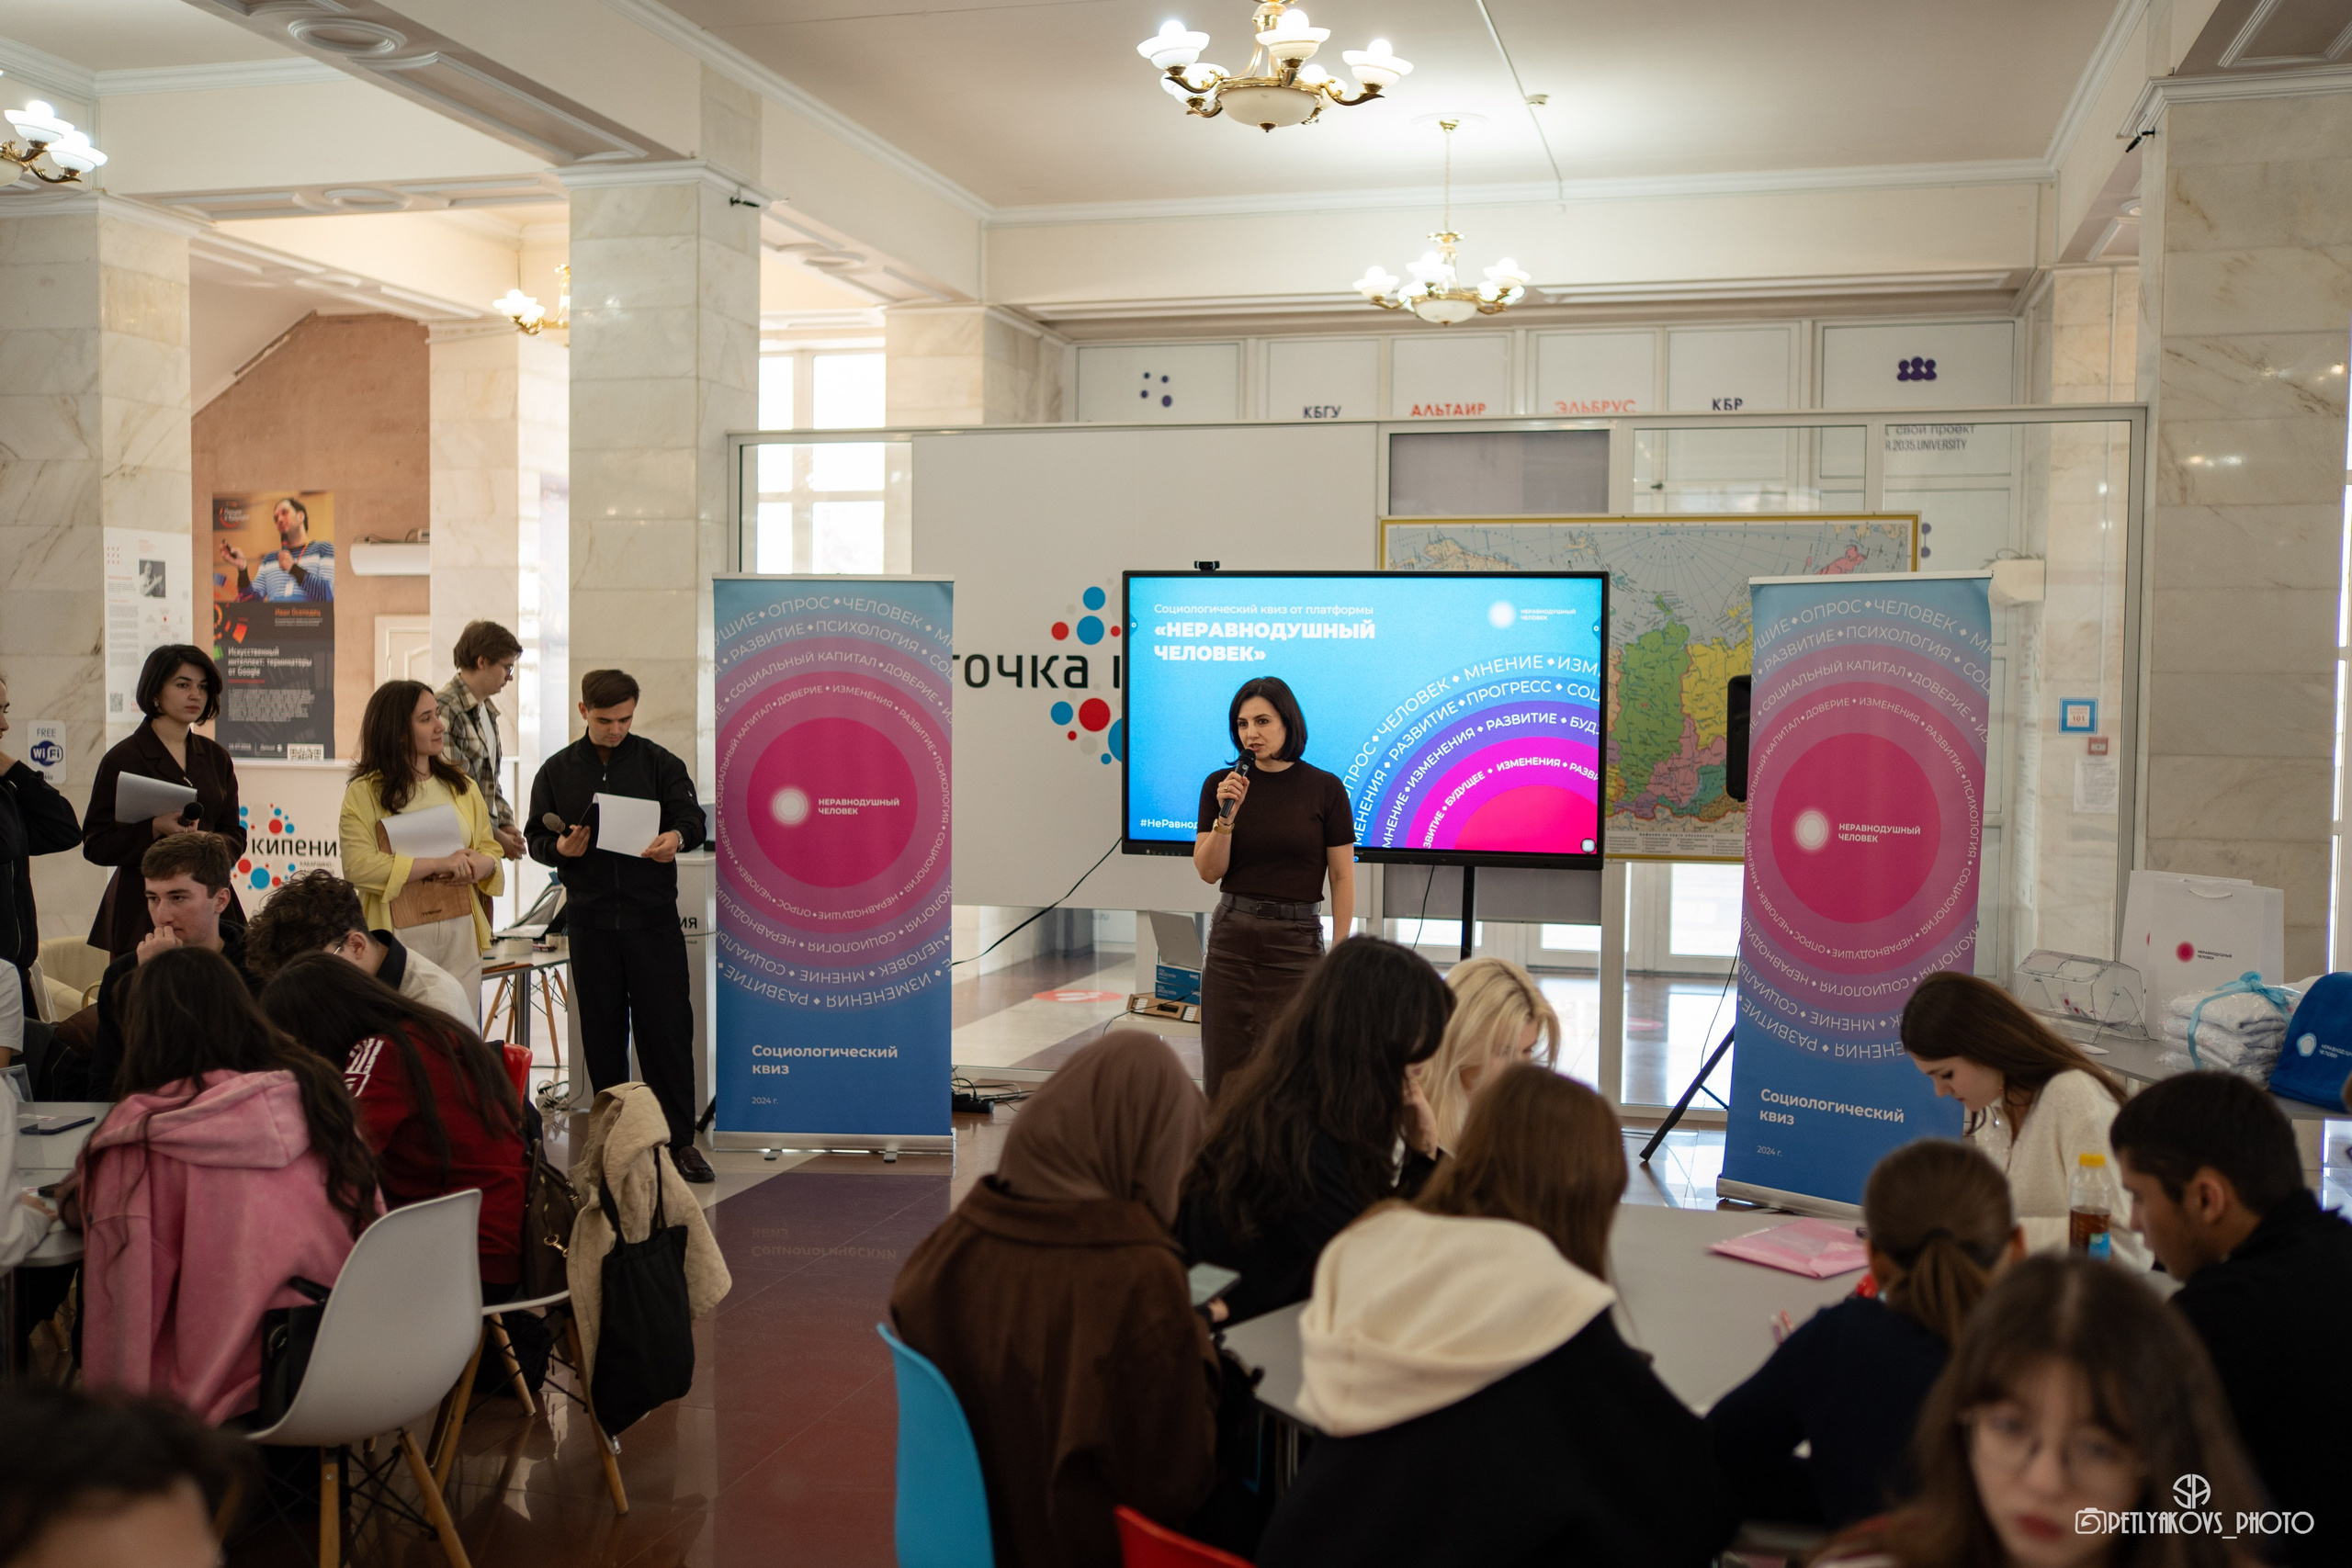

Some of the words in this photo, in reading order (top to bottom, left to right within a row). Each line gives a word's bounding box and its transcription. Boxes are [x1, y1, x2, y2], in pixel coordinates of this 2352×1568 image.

[1303, 405, 1341, 419] КБГУ
[1410, 402, 1487, 417] АЛЬТАИР
[1555, 399, 1636, 414] ЭЛЬБРУС
[1712, 398, 1744, 412] КБР
[768, 596, 831, 617] ОПРОС
[843, 598, 923, 629] ЧЕЛОВЕК
[1154, 604, 1258, 615] Социологический
[1261, 605, 1287, 614] квиз
[1306, 604, 1374, 616] платформы
[1801, 599, 1862, 623] ОПРОС
[1874, 599, 1958, 633] ЧЕЛОВЕК
[729, 623, 806, 661] РАЗВИТИЕ
[816, 620, 920, 653] ПСИХОЛОГИЯ
[1154, 619, 1375, 640] «НЕРАВНОДУШНЫЙ
[1154, 645, 1267, 661] ЧЕЛОВЕК»
[1764, 628, 1836, 671] РАЗВИТИЕ
[1846, 626, 1952, 660] ПСИХОЛОГИЯ
[729, 651, 815, 699] СОЦИАЛЬНЫЙ
[818, 651, 876, 668] КАПИТАЛ
[883, 662, 939, 703] ДОВЕРИЕ
[953, 654, 1089, 688] очка
[776, 684, 823, 706] ДОВЕРИЕ
[832, 684, 894, 709] ИЗМЕНЕНИЯ
[1376, 676, 1453, 734] ЧЕЛОВЕК
[1464, 655, 1544, 682] МНЕНИЕ
[1762, 660, 1843, 711] СОЦИАЛЬНЫЙ
[1846, 660, 1906, 678] КАПИТАЛ
[1911, 671, 1972, 718] ДОВЕРИЕ
[738, 703, 774, 740] КАПИТАЛ
[1388, 700, 1459, 761] РАЗВИТИЕ
[1465, 680, 1552, 705] ПРОГРЕСС
[1805, 696, 1850, 720] ДОВЕРИЕ
[1859, 696, 1920, 725] ИЗМЕНЕНИЯ
[37, 728, 56, 738] FREE
[899, 708, 937, 752] РАЗВИТИЕ
[1765, 717, 1802, 756] КАПИТАЛ
[1925, 725, 1966, 775] РАЗВИТИЕ
[716, 738, 740, 809] СОЦИАЛЬНЫЙ
[933, 755, 951, 824] ПСИХОЛОГИЯ
[1382, 792, 1409, 849] МНЕНИЕ
[1407, 727, 1476, 788] ИЗМЕНЕНИЯ
[1486, 712, 1557, 731] РАЗВИТИЕ
[1444, 770, 1486, 807] БУДУЩЕЕ
[1496, 756, 1561, 772] ИЗМЕНЕНИЯ
[818, 797, 900, 808] НЕРАВНОДУШНЫЙ
[1747, 754, 1769, 830] СОЦИАЛЬНЫЙ
[818, 807, 858, 816] ЧЕЛОВЕК
[1962, 779, 1980, 859] ПСИХОЛОГИЯ
[718, 818, 736, 860] МНЕНИЕ
[1838, 823, 1921, 835] НЕРАВНОДУШНЫЙ
[1838, 833, 1878, 842] ЧЕЛОВЕК
[903, 832, 945, 893] СОЦИОЛОГИЯ
[1747, 839, 1759, 885] МНЕНИЕ
[736, 863, 775, 900] ЧЕЛОВЕК
[776, 898, 812, 918] ОПРОС
[818, 893, 899, 920] НЕРАВНОДУШИЕ
[1758, 891, 1791, 935] ЧЕЛОВЕК
[1919, 867, 1972, 935] СОЦИОЛОГИЯ
[808, 931, 896, 953] СОЦИОЛОГИЯ
[878, 939, 945, 977] ЧЕЛОВЕК
[1792, 931, 1826, 954] ОПРОС
[1831, 935, 1915, 960] НЕРАВНОДУШИЕ
[723, 964, 808, 1006] РАЗВИТИЕ
[799, 969, 865, 985] МНЕНИЕ
[827, 972, 932, 1008] ИЗМЕНЕНИЯ
[1819, 977, 1909, 998] СОЦИОЛОГИЯ
[1742, 998, 1818, 1051] РАЗВИТИЕ
[1810, 1011, 1875, 1032] МНЕНИЕ
[752, 1044, 899, 1058] Социологический
[752, 1065, 790, 1075] квиз
[1759, 1110, 1795, 1125] квиз
[1760, 1089, 1905, 1123] Социологический
[1757, 1145, 1776, 1156] 2024
